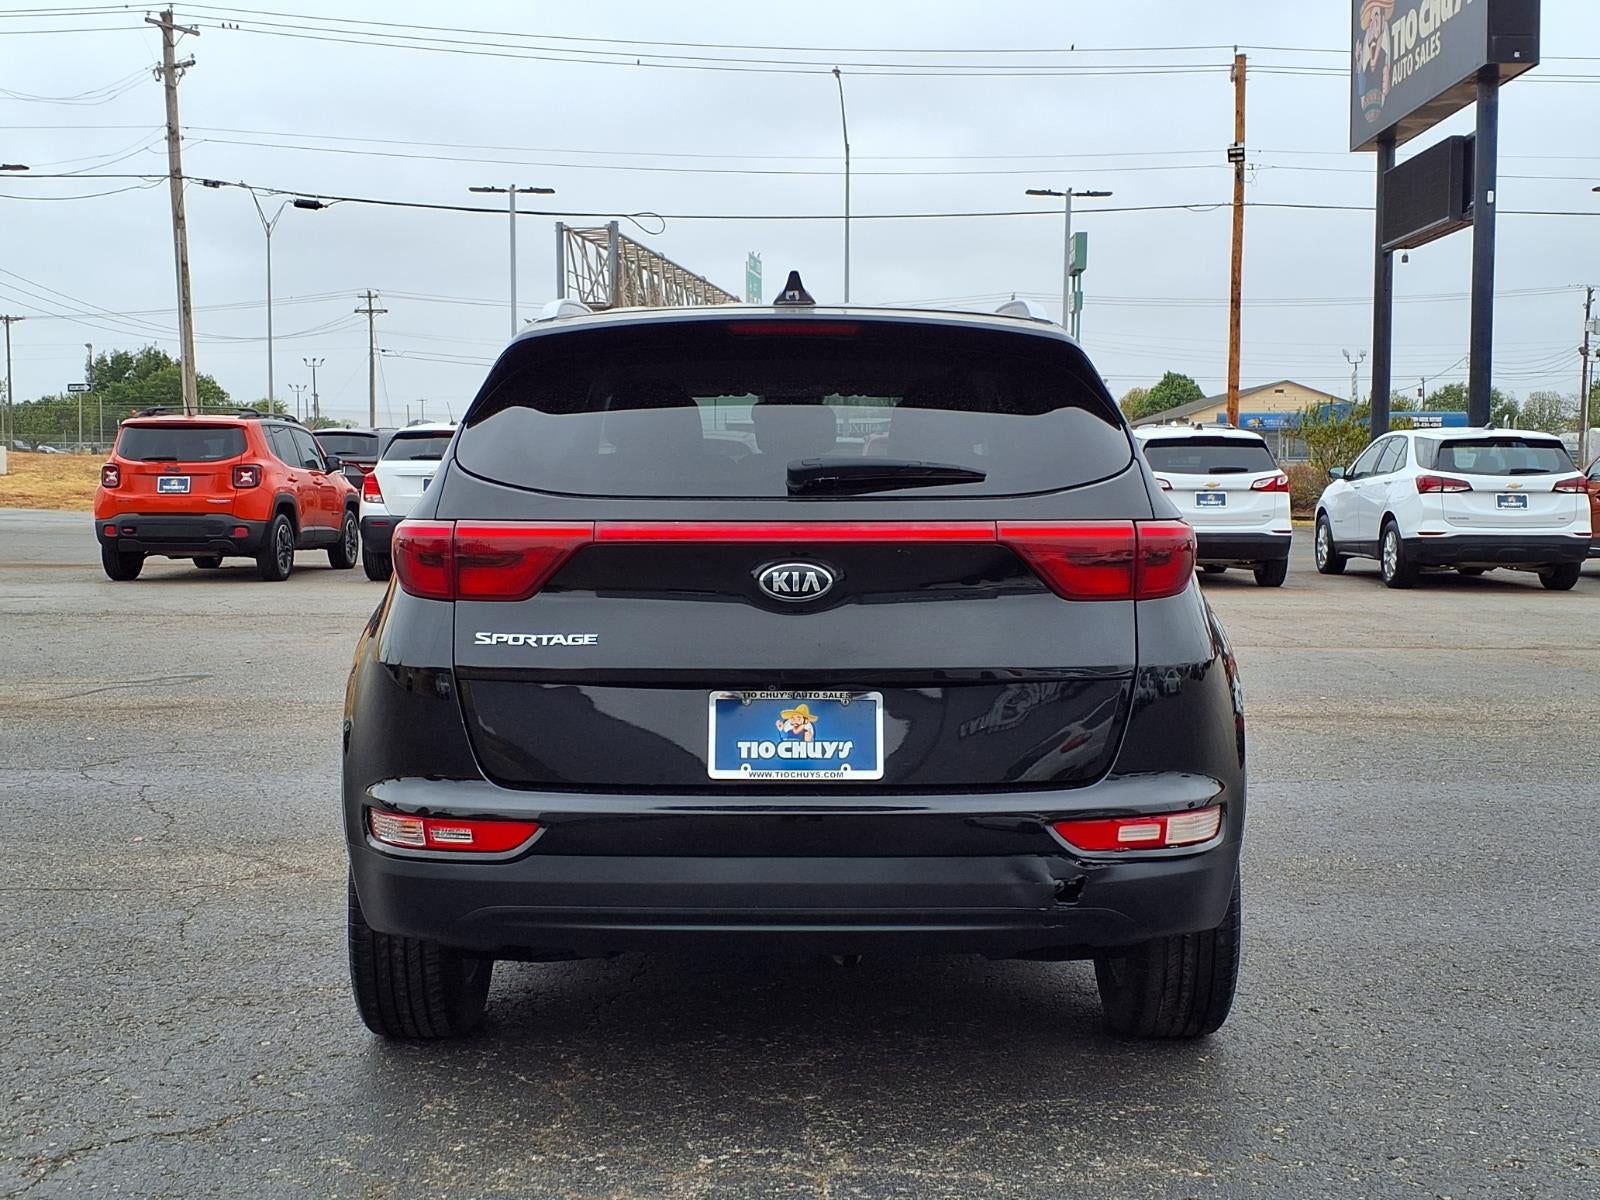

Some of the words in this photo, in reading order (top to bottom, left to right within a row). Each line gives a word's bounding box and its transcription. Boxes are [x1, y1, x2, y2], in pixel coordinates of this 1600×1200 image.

[1392, 8, 1418, 61] TIO
[1391, 53, 1414, 88] AUTO
[1415, 31, 1441, 71] SALES
[772, 571, 821, 592] KIA
[474, 632, 598, 647] SPORTAGE
[749, 771, 844, 779] WWW.TIOCHUYS.COM
